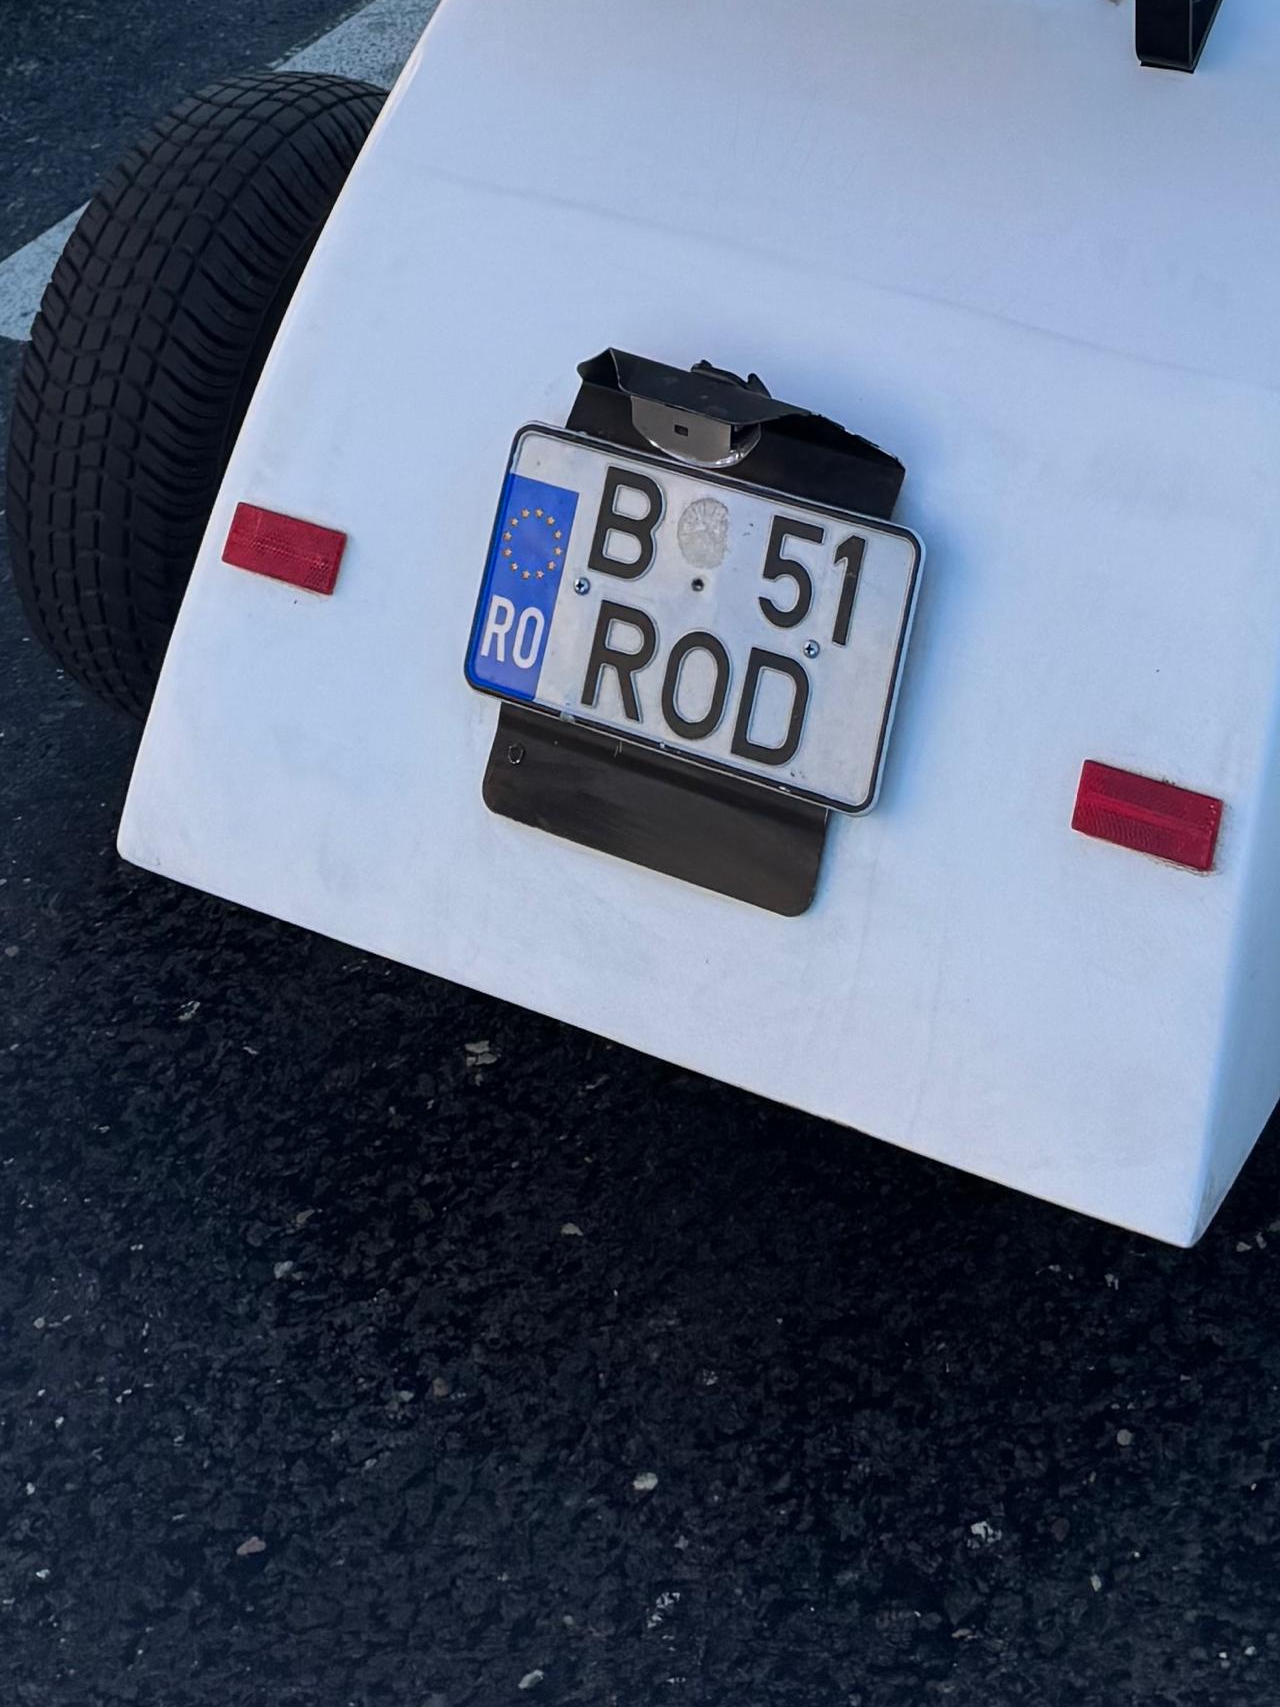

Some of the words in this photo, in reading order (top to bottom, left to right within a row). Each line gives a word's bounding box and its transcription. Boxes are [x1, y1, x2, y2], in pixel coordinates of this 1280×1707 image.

[480, 594, 546, 671] RO
[587, 465, 666, 581] B
[758, 514, 867, 647] 51
[580, 599, 811, 767] ROD
